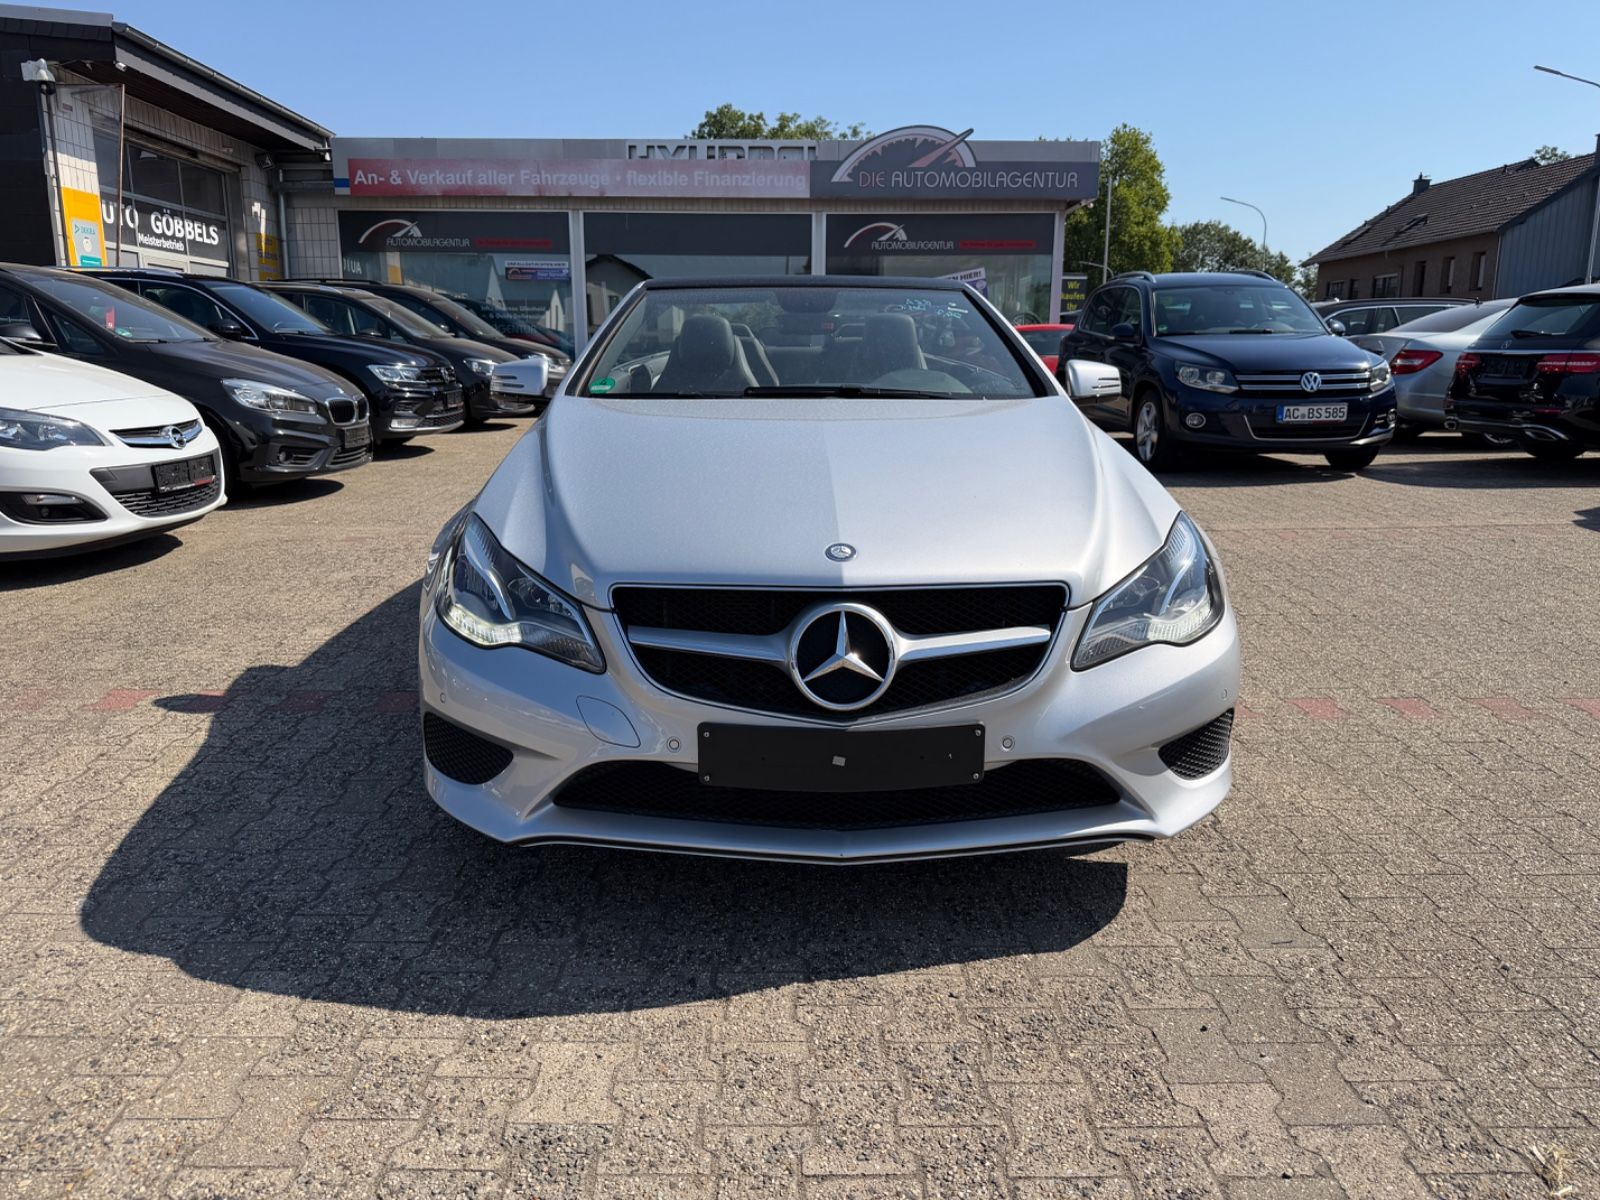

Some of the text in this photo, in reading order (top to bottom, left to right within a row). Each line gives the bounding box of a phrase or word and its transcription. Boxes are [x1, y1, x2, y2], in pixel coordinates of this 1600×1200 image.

[354, 169, 806, 190] An- & Verkauf aller Fahrzeuge flexible Finanzierung
[859, 171, 1078, 188] DIE AUTOMOBILAGENTUR
[150, 209, 220, 246] GÖBBELS
[138, 232, 185, 252] Meisterbetrieb
[386, 238, 470, 247] AUTOMOBILAGENTUR
[871, 240, 954, 250] AUTOMOBILAGENTUR
[1067, 281, 1080, 289] Wir
[1284, 406, 1346, 420] AC BS 585
